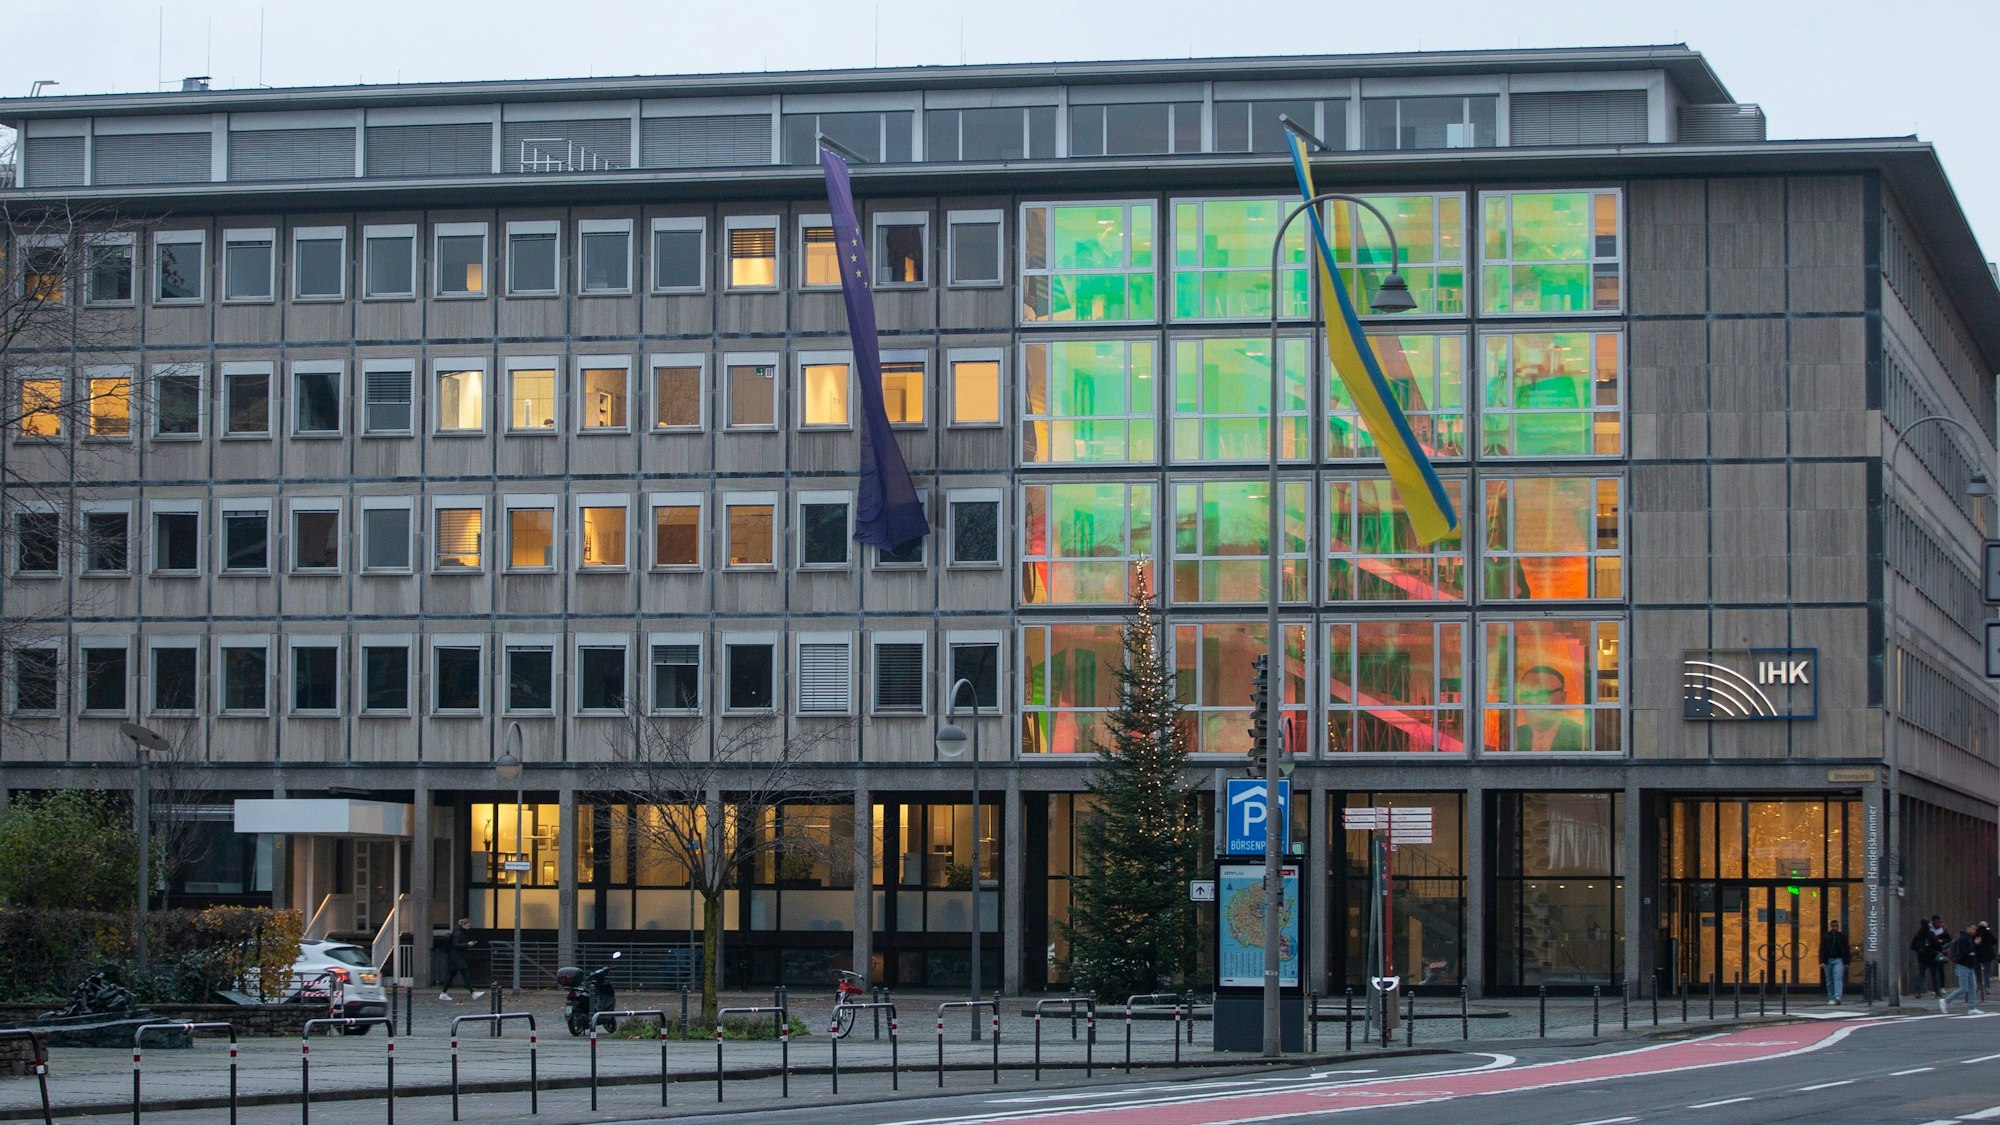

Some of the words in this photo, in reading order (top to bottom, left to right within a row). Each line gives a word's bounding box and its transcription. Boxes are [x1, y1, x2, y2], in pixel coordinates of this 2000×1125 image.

[1759, 661, 1809, 684] IHK
[1243, 801, 1267, 837] P
[1231, 838, 1284, 851] BÖRSENP
[1867, 805, 1877, 879] Handelskammer
[1867, 885, 1877, 902] und
[1867, 906, 1877, 952] Industrie-
